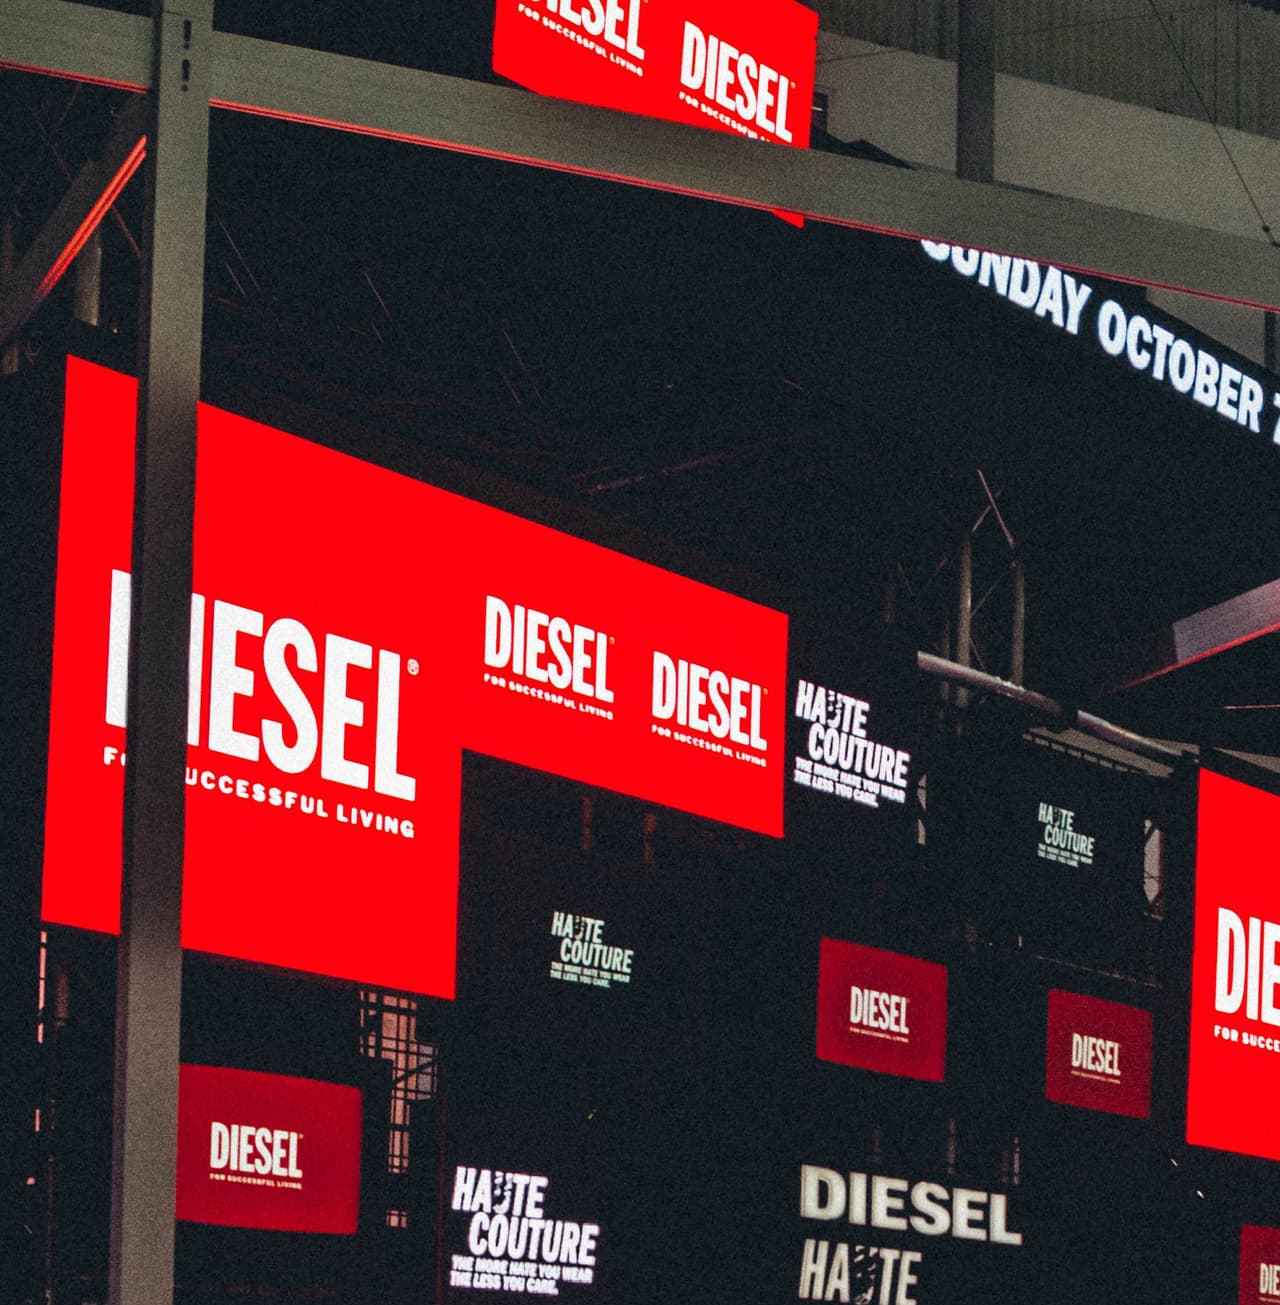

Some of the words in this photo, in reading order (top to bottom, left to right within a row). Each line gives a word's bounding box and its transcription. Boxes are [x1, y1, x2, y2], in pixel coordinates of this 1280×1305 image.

[518, 3, 540, 21] FOR
[542, 16, 608, 58] SUCCESSFUL
[610, 51, 644, 77] LIVING
[526, 0, 645, 60] SEL
[679, 91, 699, 109] FOR
[680, 21, 793, 143] DIESEL
[1098, 300, 1263, 432] OCTOBER
[484, 595, 614, 703] DIESEL
[483, 672, 507, 689] FOR
[508, 680, 577, 709] SUCCESSFUL
[579, 702, 614, 721] LIVING
[652, 650, 767, 751] DIESEL
[651, 724, 672, 738] FOR
[673, 731, 733, 758] SUCCESSFUL
[735, 751, 767, 767] LIVING
[808, 722, 910, 788] COUTURE
[185, 766, 329, 818] UCCESSFUL
[336, 803, 415, 838] LIVING
[1044, 824, 1096, 857] COUTURE
[560, 937, 635, 974] COUTURE
[849, 985, 910, 1034] DIESEL
[1214, 1024, 1239, 1042] FOR
[1071, 1032, 1122, 1076] DIESEL
[210, 1121, 303, 1178] DIESEL
[800, 1164, 1023, 1246] DIESEL
[468, 1212, 600, 1267] COUTURE
[450, 1270, 472, 1287] THE
[472, 1272, 502, 1290] LESS
[503, 1275, 525, 1291] YOU
[452, 1254, 474, 1271] THE
[474, 1257, 508, 1275] MORE
[509, 1261, 537, 1277] HATE
[538, 1263, 561, 1280] YOU
[561, 1266, 593, 1284] WEAR
